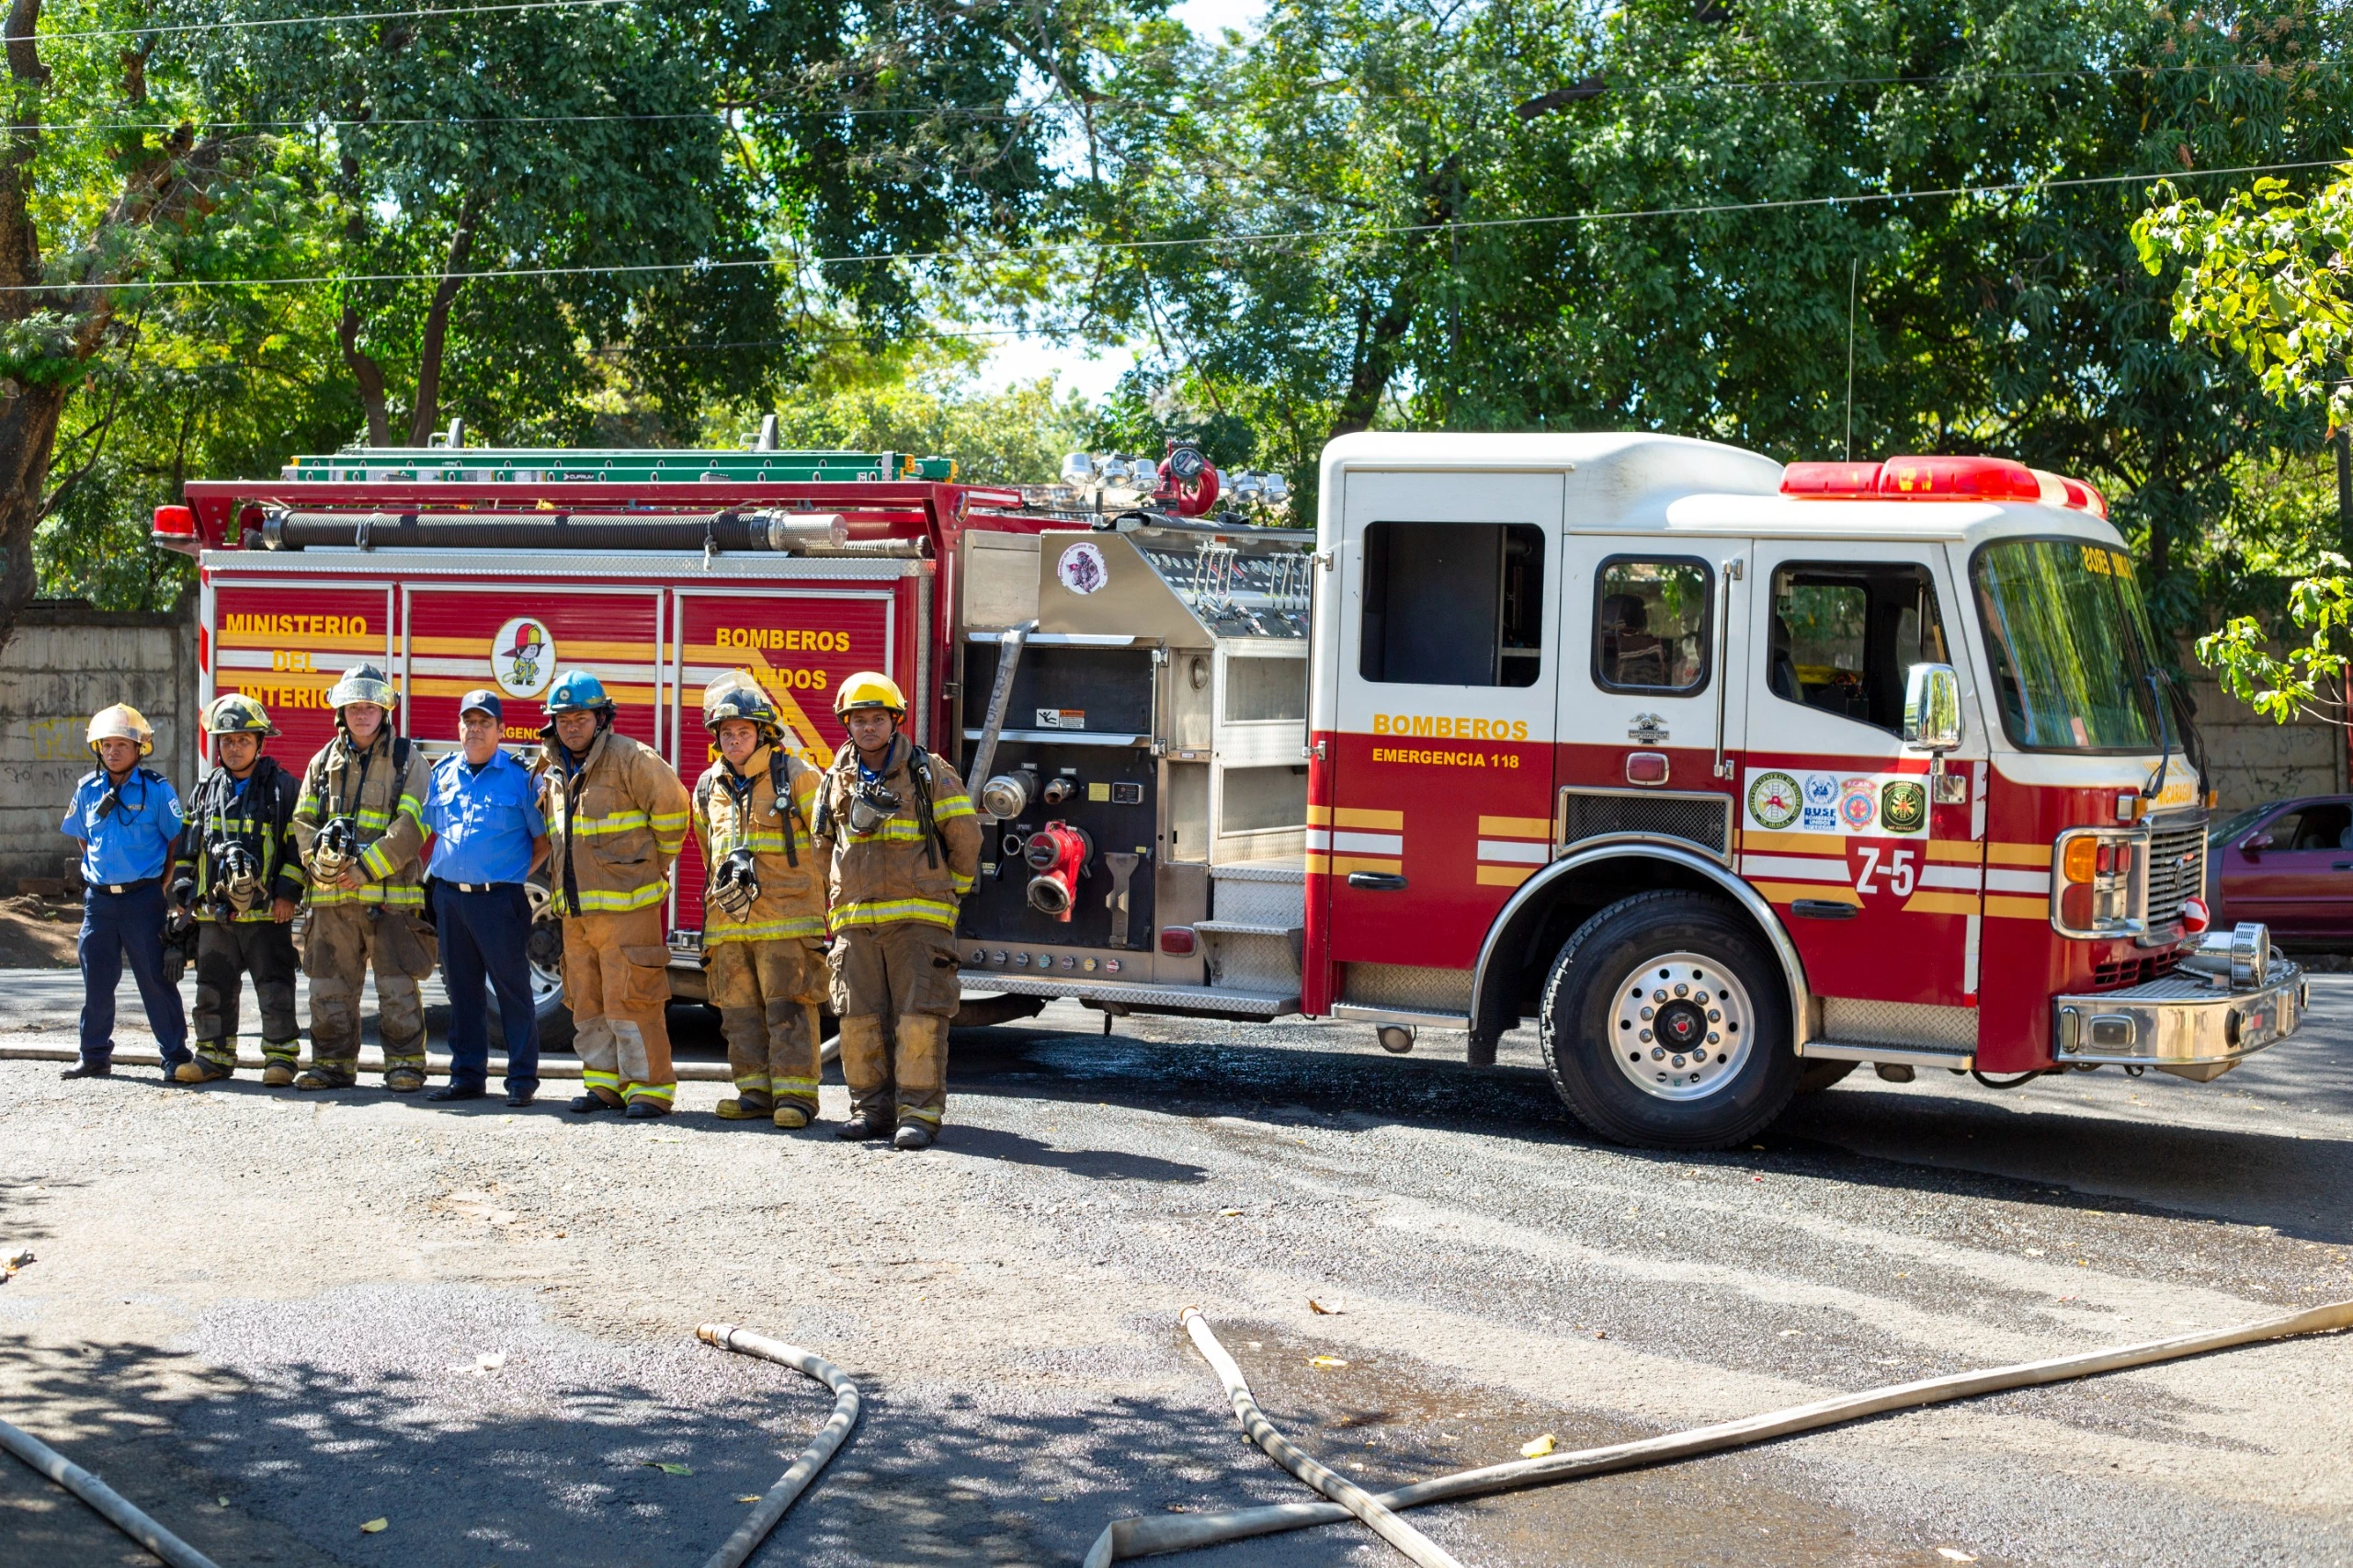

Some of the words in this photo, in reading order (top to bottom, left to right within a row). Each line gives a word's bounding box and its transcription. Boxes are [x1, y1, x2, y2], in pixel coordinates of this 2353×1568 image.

[226, 614, 367, 638] MINISTERIO
[716, 628, 850, 652] BOMBEROS
[273, 650, 317, 673] DEL
[239, 684, 332, 709] INTERIO
[1373, 713, 1529, 741] BOMBEROS
[1372, 748, 1486, 767] EMERGENCIA
[1491, 754, 1519, 768] 118
[1857, 846, 1915, 897] Z-5
